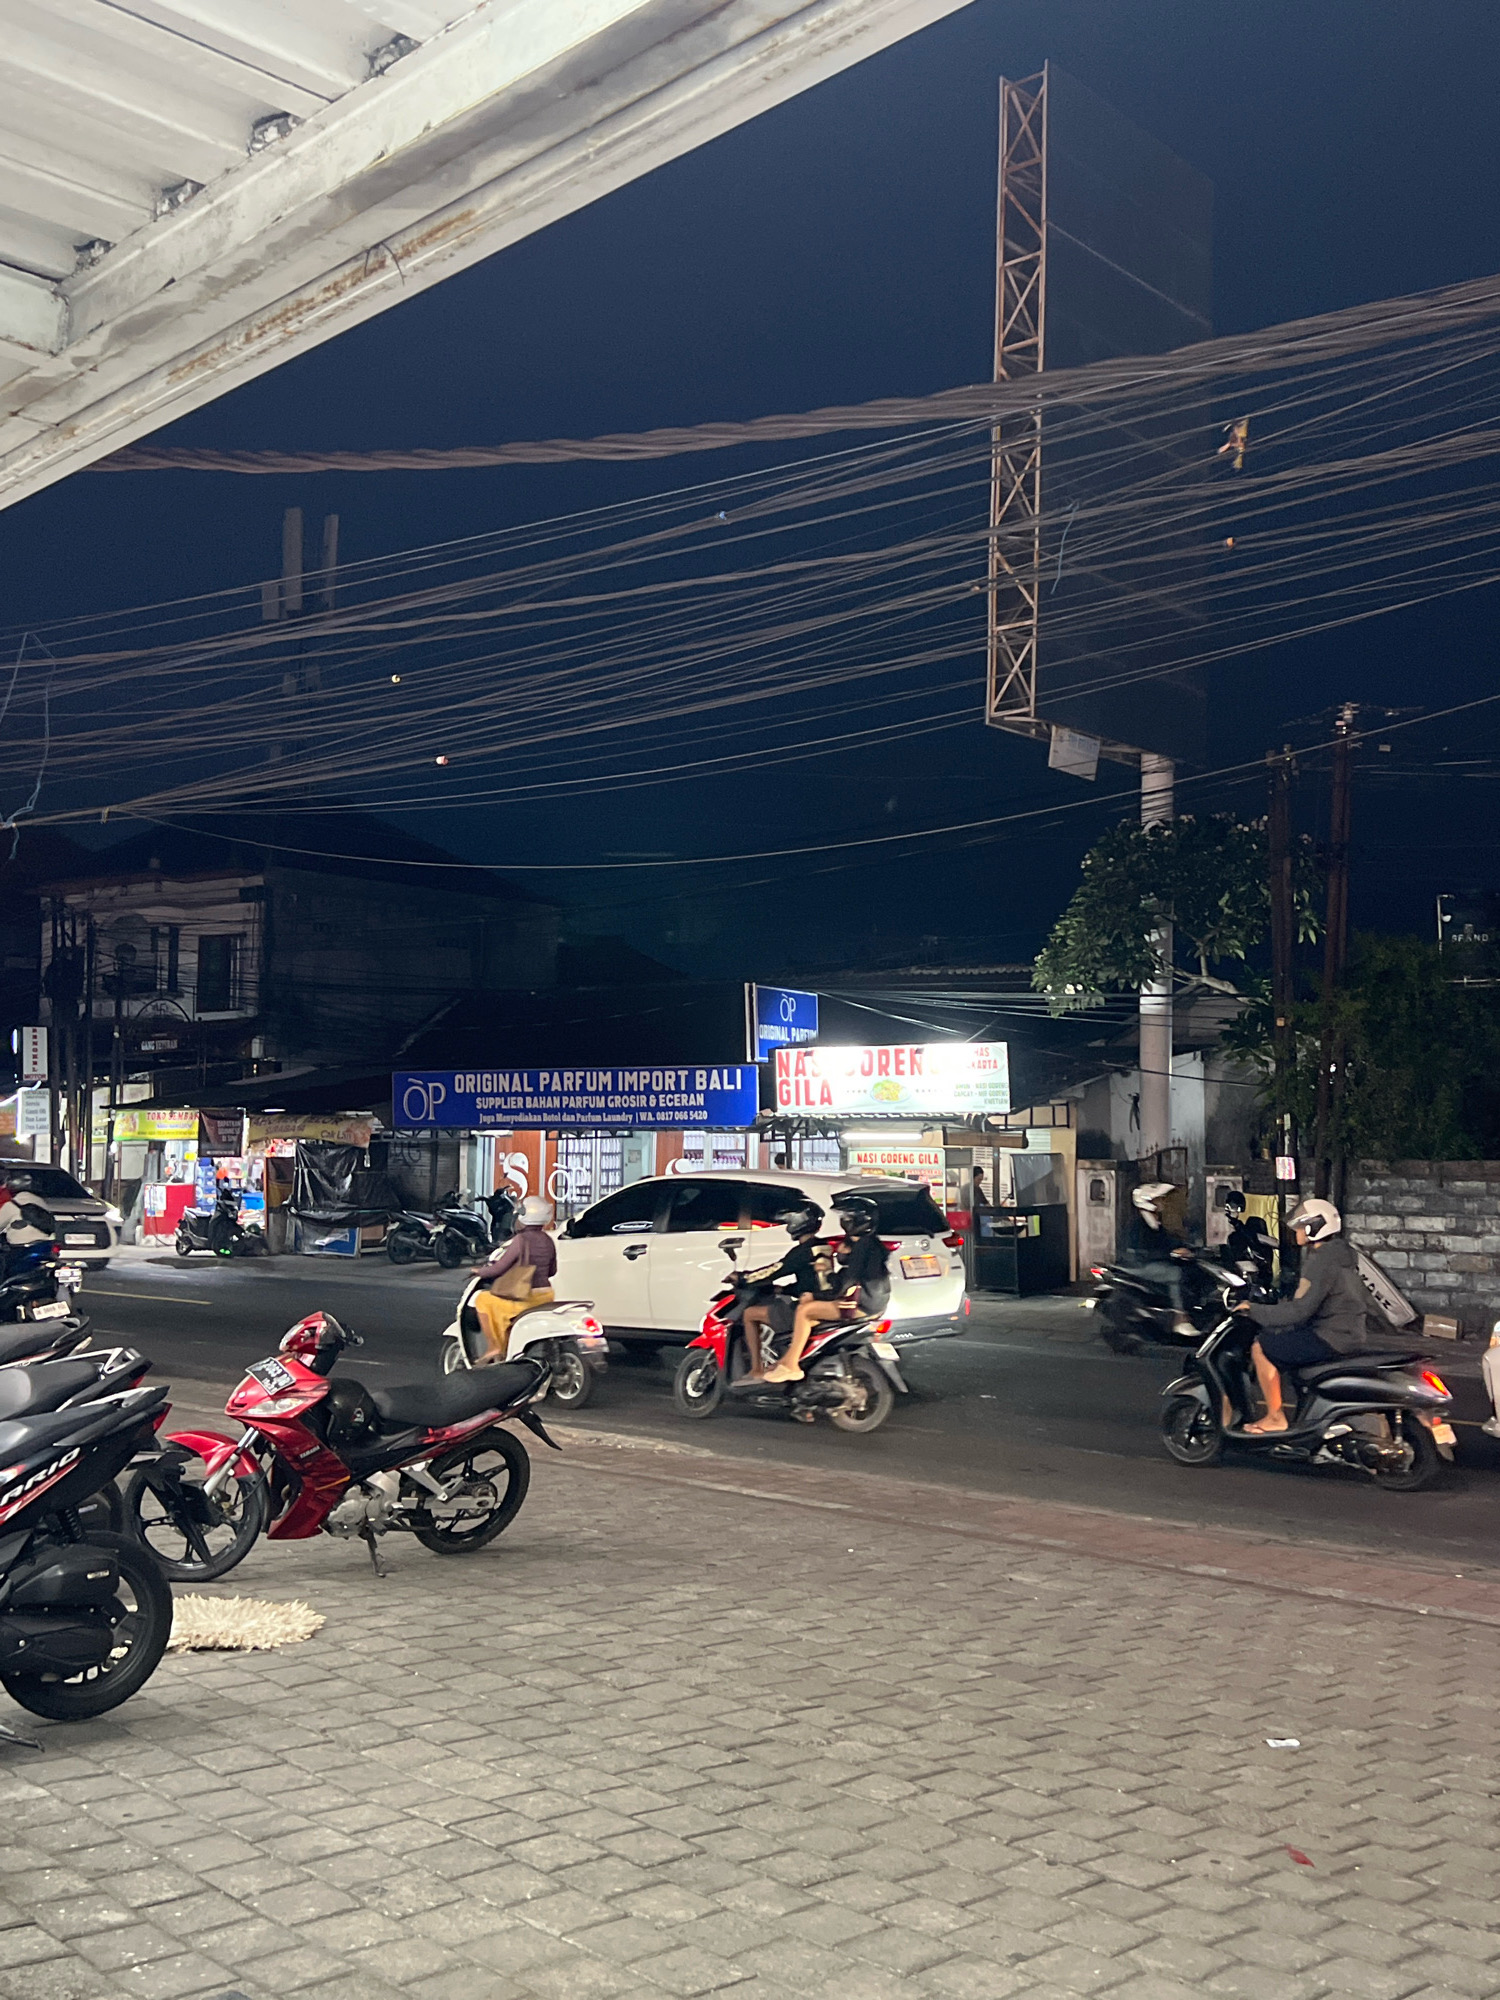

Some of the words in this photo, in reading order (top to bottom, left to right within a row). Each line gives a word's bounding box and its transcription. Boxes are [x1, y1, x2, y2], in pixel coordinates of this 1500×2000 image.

[759, 1024, 790, 1042] ORIGINAL
[454, 1073, 534, 1094] ORIGINAL
[539, 1071, 612, 1092] PARFUM
[618, 1069, 689, 1092] IMPORT
[695, 1068, 742, 1091] BALI
[778, 1078, 833, 1106] GILA
[475, 1096, 524, 1109] SUPPLIER
[525, 1096, 560, 1109] BAHAN
[562, 1095, 605, 1109] PARFUM
[607, 1094, 647, 1108] GROSIR
[649, 1094, 657, 1108] &
[658, 1093, 705, 1107] ECERAN
[146, 1112, 166, 1120] TOKO
[479, 1113, 495, 1124] Juga
[495, 1112, 542, 1124] Menyediakan
[543, 1112, 561, 1122] Botol
[562, 1112, 575, 1122] dan
[576, 1112, 602, 1122] Parfum
[603, 1111, 633, 1124] Laundry
[857, 1153, 878, 1164] NASI
[880, 1153, 915, 1164] GORENG
[918, 1153, 939, 1165] GILA
